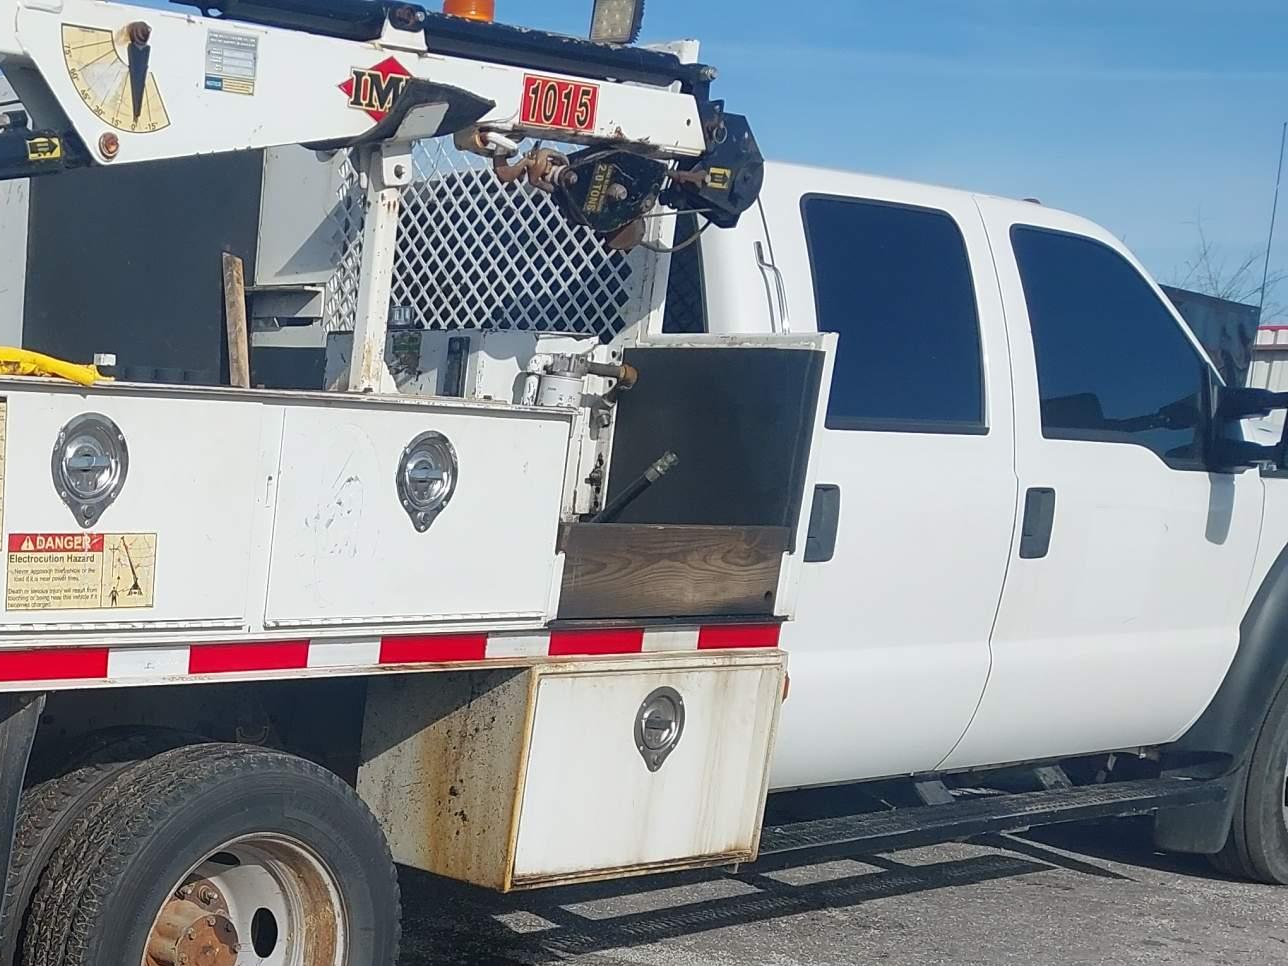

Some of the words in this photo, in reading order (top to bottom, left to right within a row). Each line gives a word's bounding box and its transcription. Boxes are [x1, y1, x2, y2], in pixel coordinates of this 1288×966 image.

[528, 80, 593, 128] 1015
[36, 536, 92, 550] DANGER
[10, 554, 65, 563] Electrocution
[67, 554, 95, 563] Hazard
